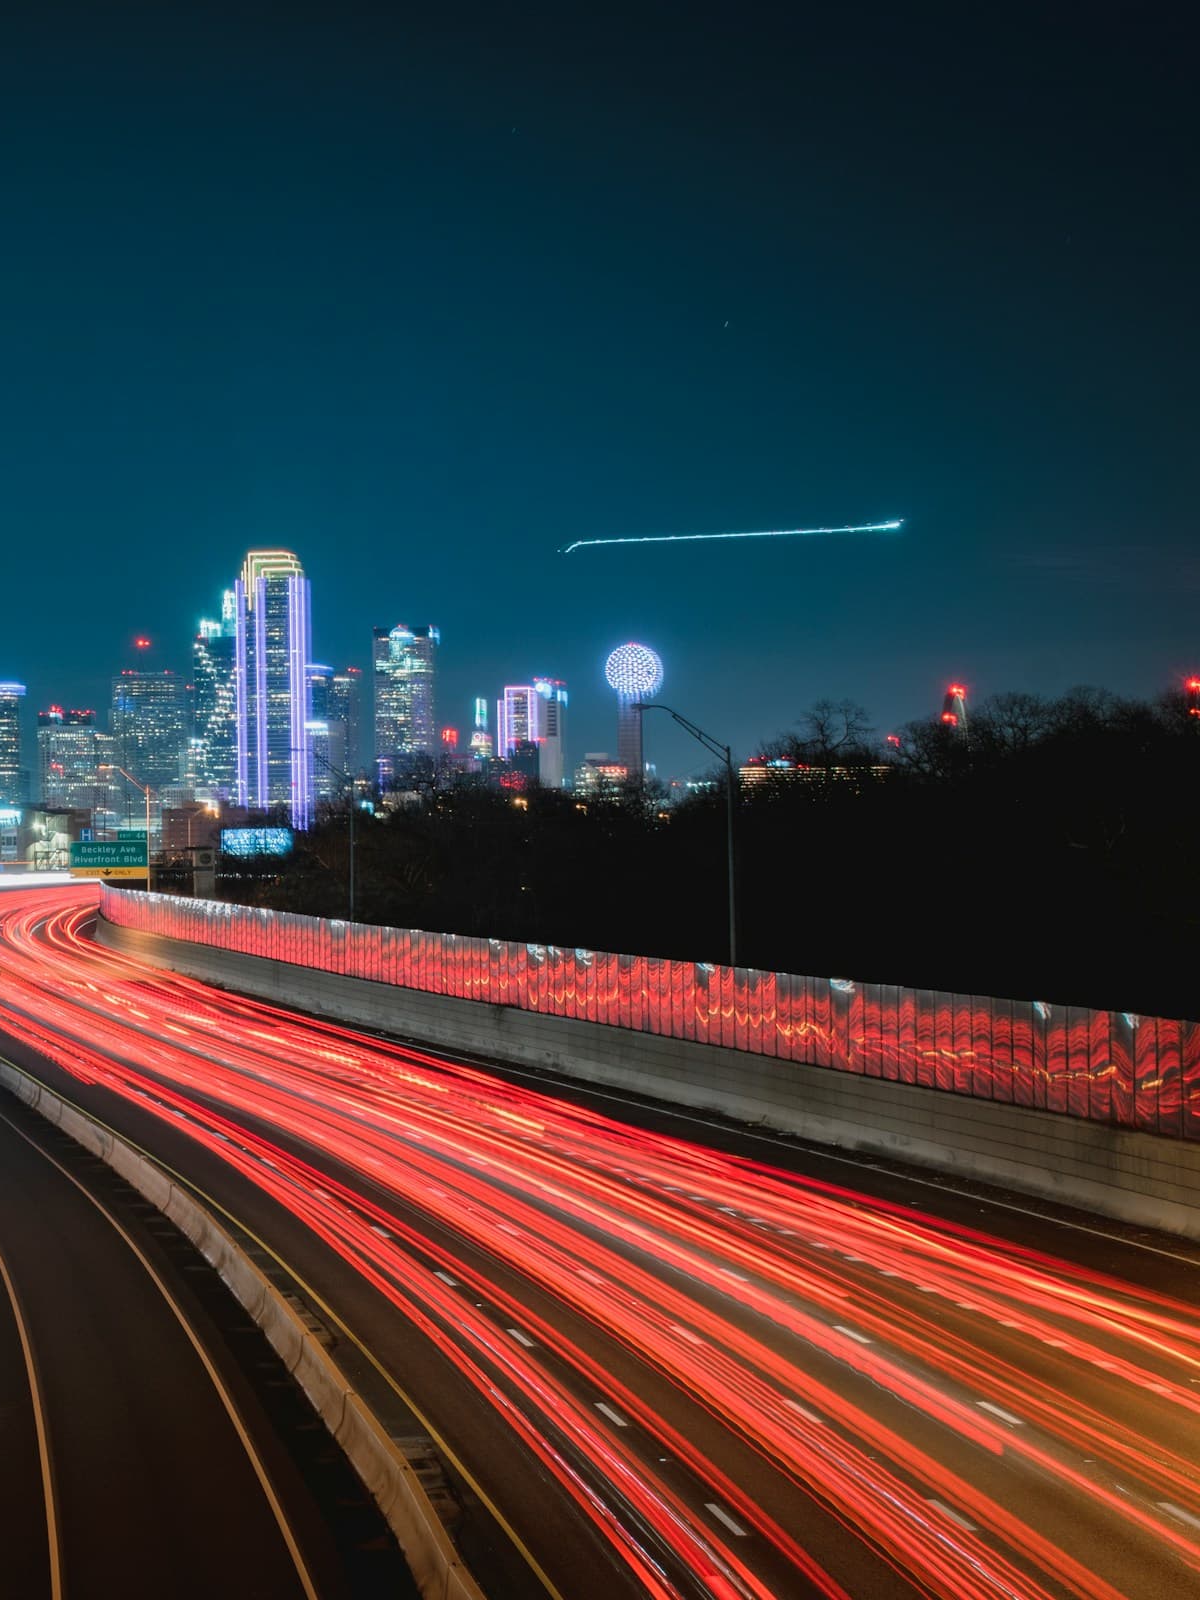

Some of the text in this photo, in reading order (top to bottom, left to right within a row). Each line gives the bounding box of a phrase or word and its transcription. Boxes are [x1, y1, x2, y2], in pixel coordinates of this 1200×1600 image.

[81, 846, 136, 855] Beckley Ave
[74, 855, 143, 864] Riverfront Blvd
